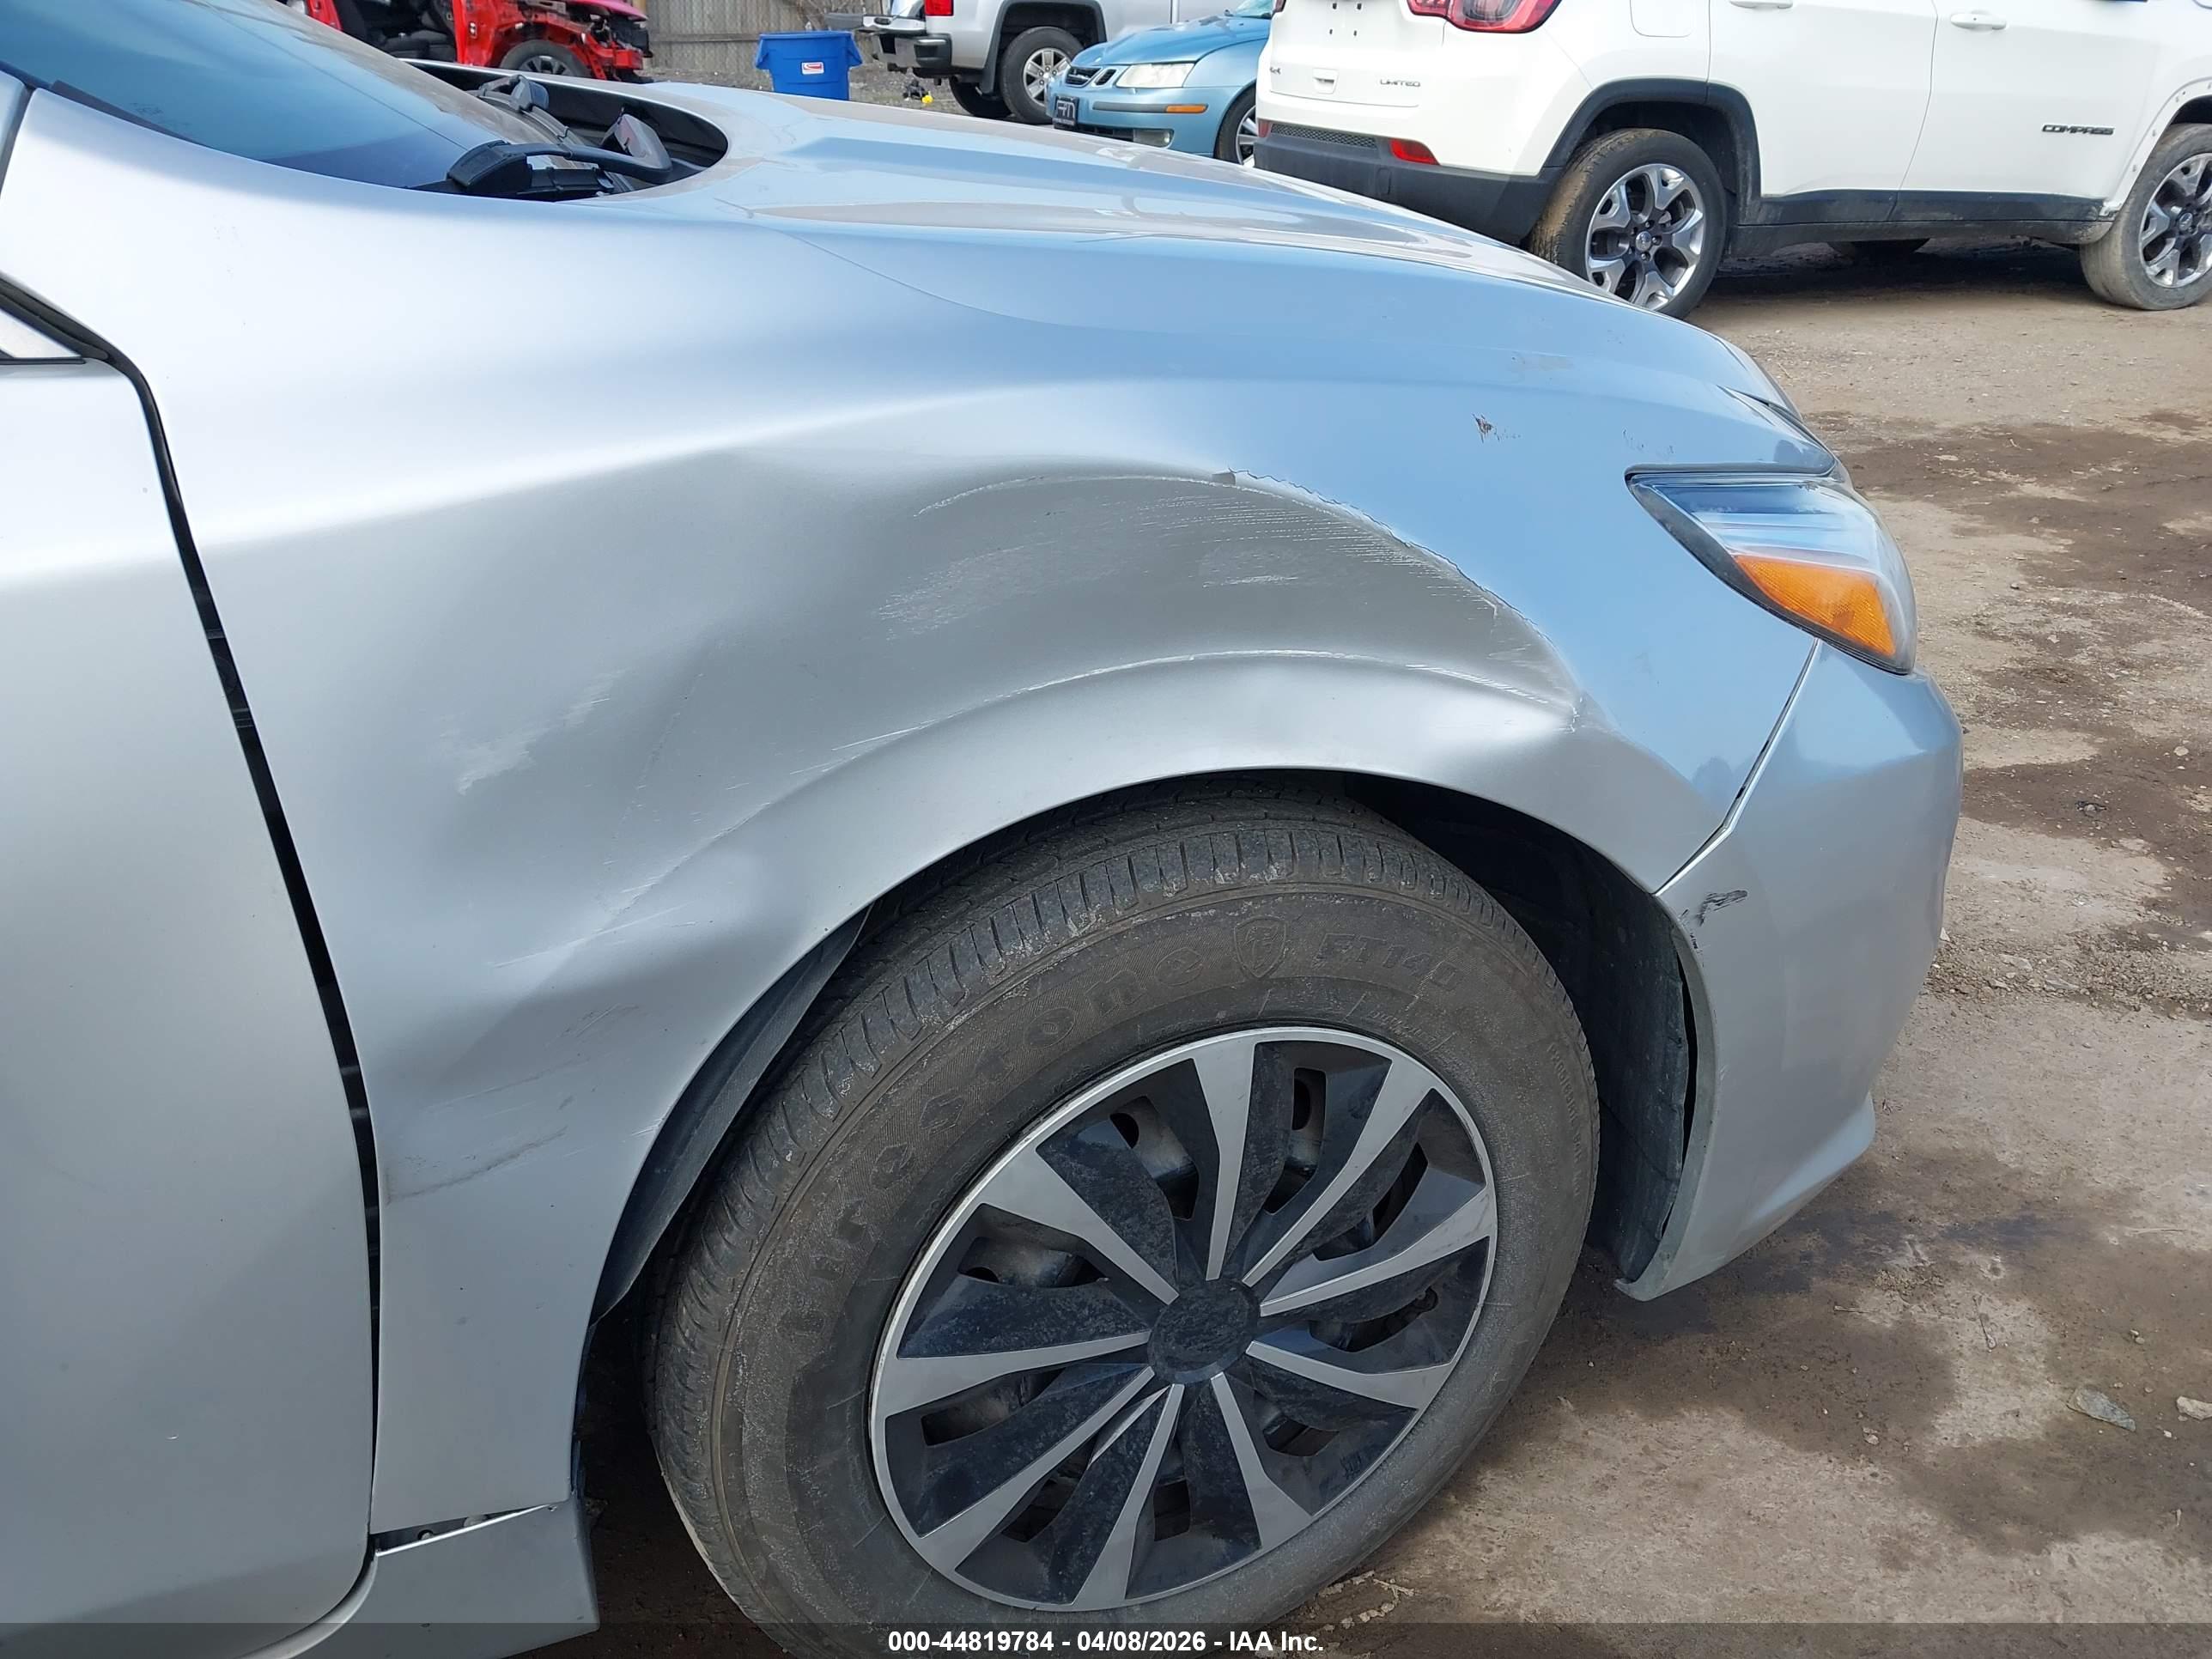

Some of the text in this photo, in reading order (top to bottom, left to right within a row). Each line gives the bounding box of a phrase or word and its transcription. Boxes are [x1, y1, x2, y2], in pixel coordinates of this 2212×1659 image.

[1380, 78, 1421, 87] LIMITED
[2042, 124, 2115, 136] COMPASS
[1311, 931, 1465, 992] FT140
